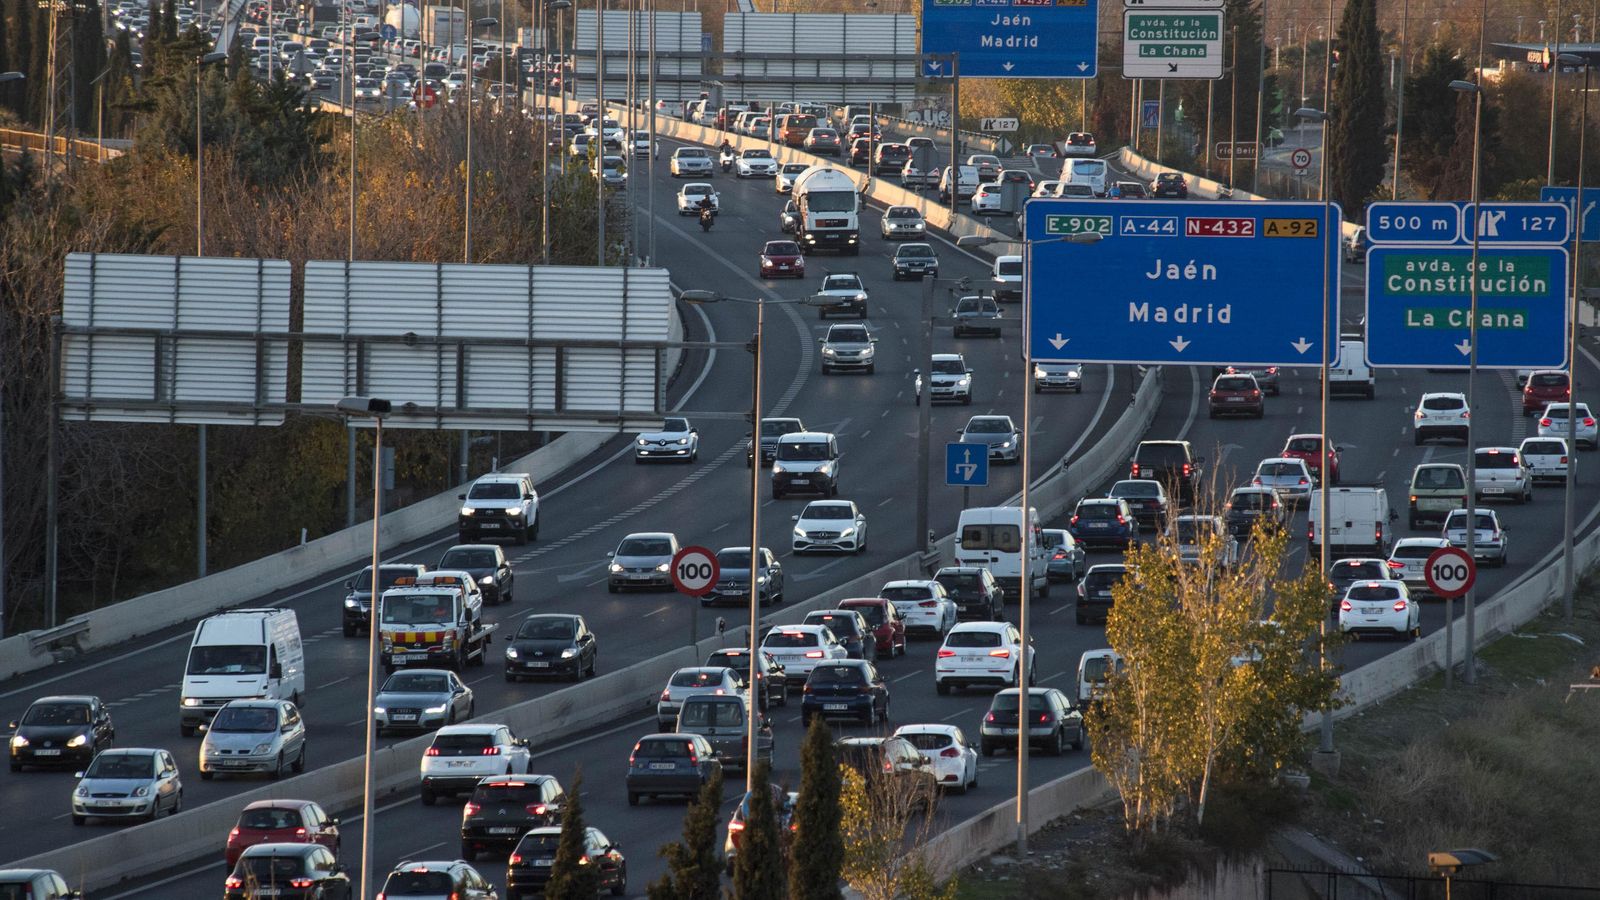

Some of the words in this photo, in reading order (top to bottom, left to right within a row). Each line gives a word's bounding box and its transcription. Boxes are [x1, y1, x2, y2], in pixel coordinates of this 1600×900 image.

[991, 14, 1031, 26] Jaén
[1140, 19, 1167, 27] avda.
[1173, 19, 1185, 27] de
[1191, 19, 1200, 27] la
[981, 35, 1038, 47] Madrid
[1130, 28, 1217, 39] Constitución
[1141, 46, 1156, 55] La
[1163, 46, 1205, 55] Chana
[1049, 217, 1111, 232] E-902
[1123, 219, 1175, 233] A-44
[1188, 220, 1254, 234] N-432
[1267, 221, 1316, 235] A-92
[1379, 215, 1422, 230] 500
[1432, 219, 1448, 230] m
[1521, 216, 1557, 231] 127
[1146, 259, 1217, 280] Jaén
[1406, 258, 1456, 272] avda.
[1499, 260, 1515, 272] la
[1129, 302, 1232, 324] Madrid
[1407, 310, 1434, 326] La
[679, 563, 712, 580] 100
[1433, 564, 1467, 581] 100
